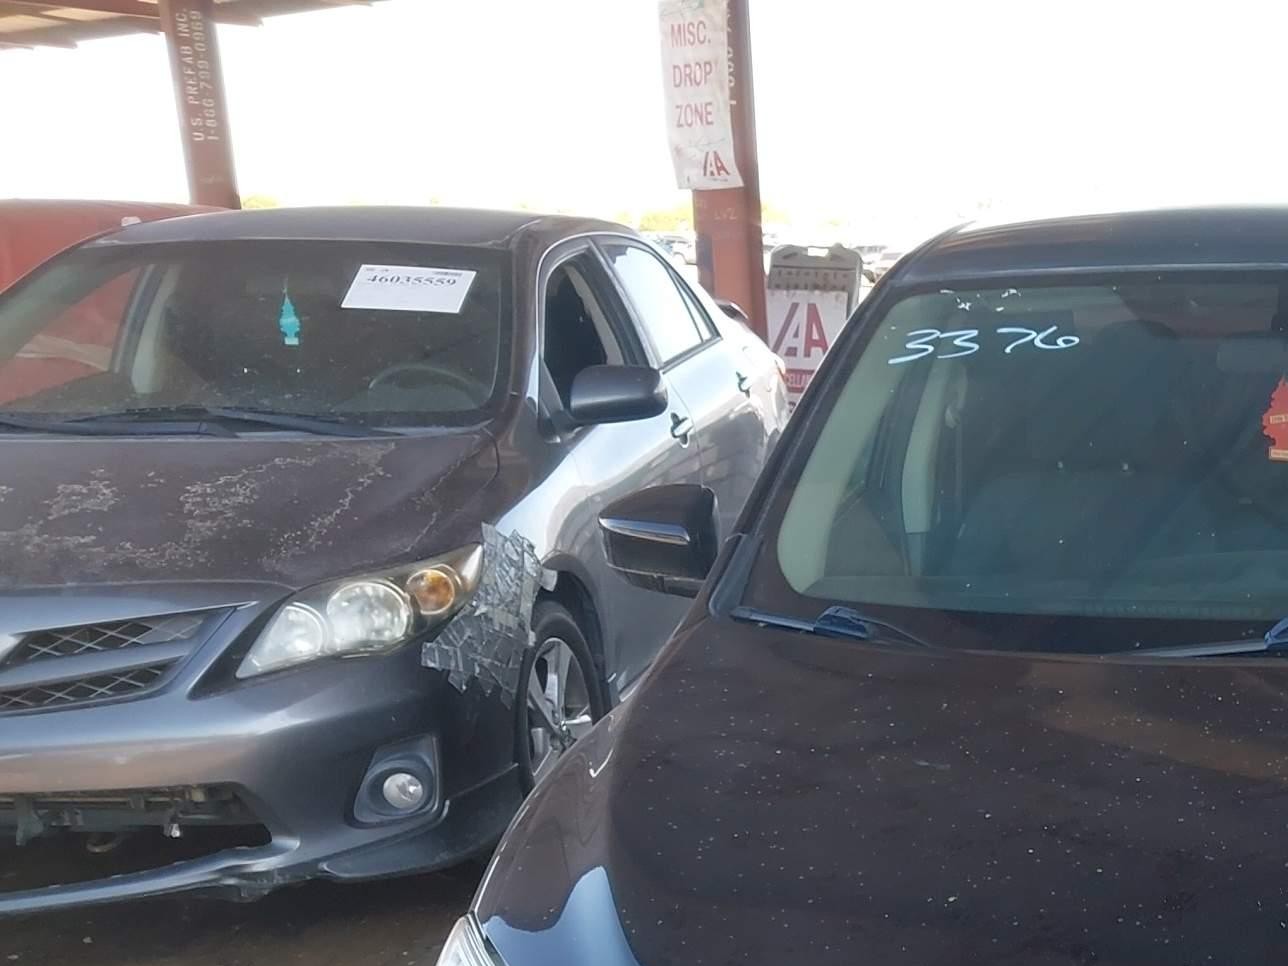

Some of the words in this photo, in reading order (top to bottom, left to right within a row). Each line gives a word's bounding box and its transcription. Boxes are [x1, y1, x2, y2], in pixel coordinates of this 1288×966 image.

[176, 8, 191, 37] INC.
[670, 21, 711, 47] MISC.
[180, 45, 200, 105] PREFAB
[672, 62, 713, 88] DROP
[191, 113, 206, 141] U.S.
[675, 102, 714, 128] ZONE
